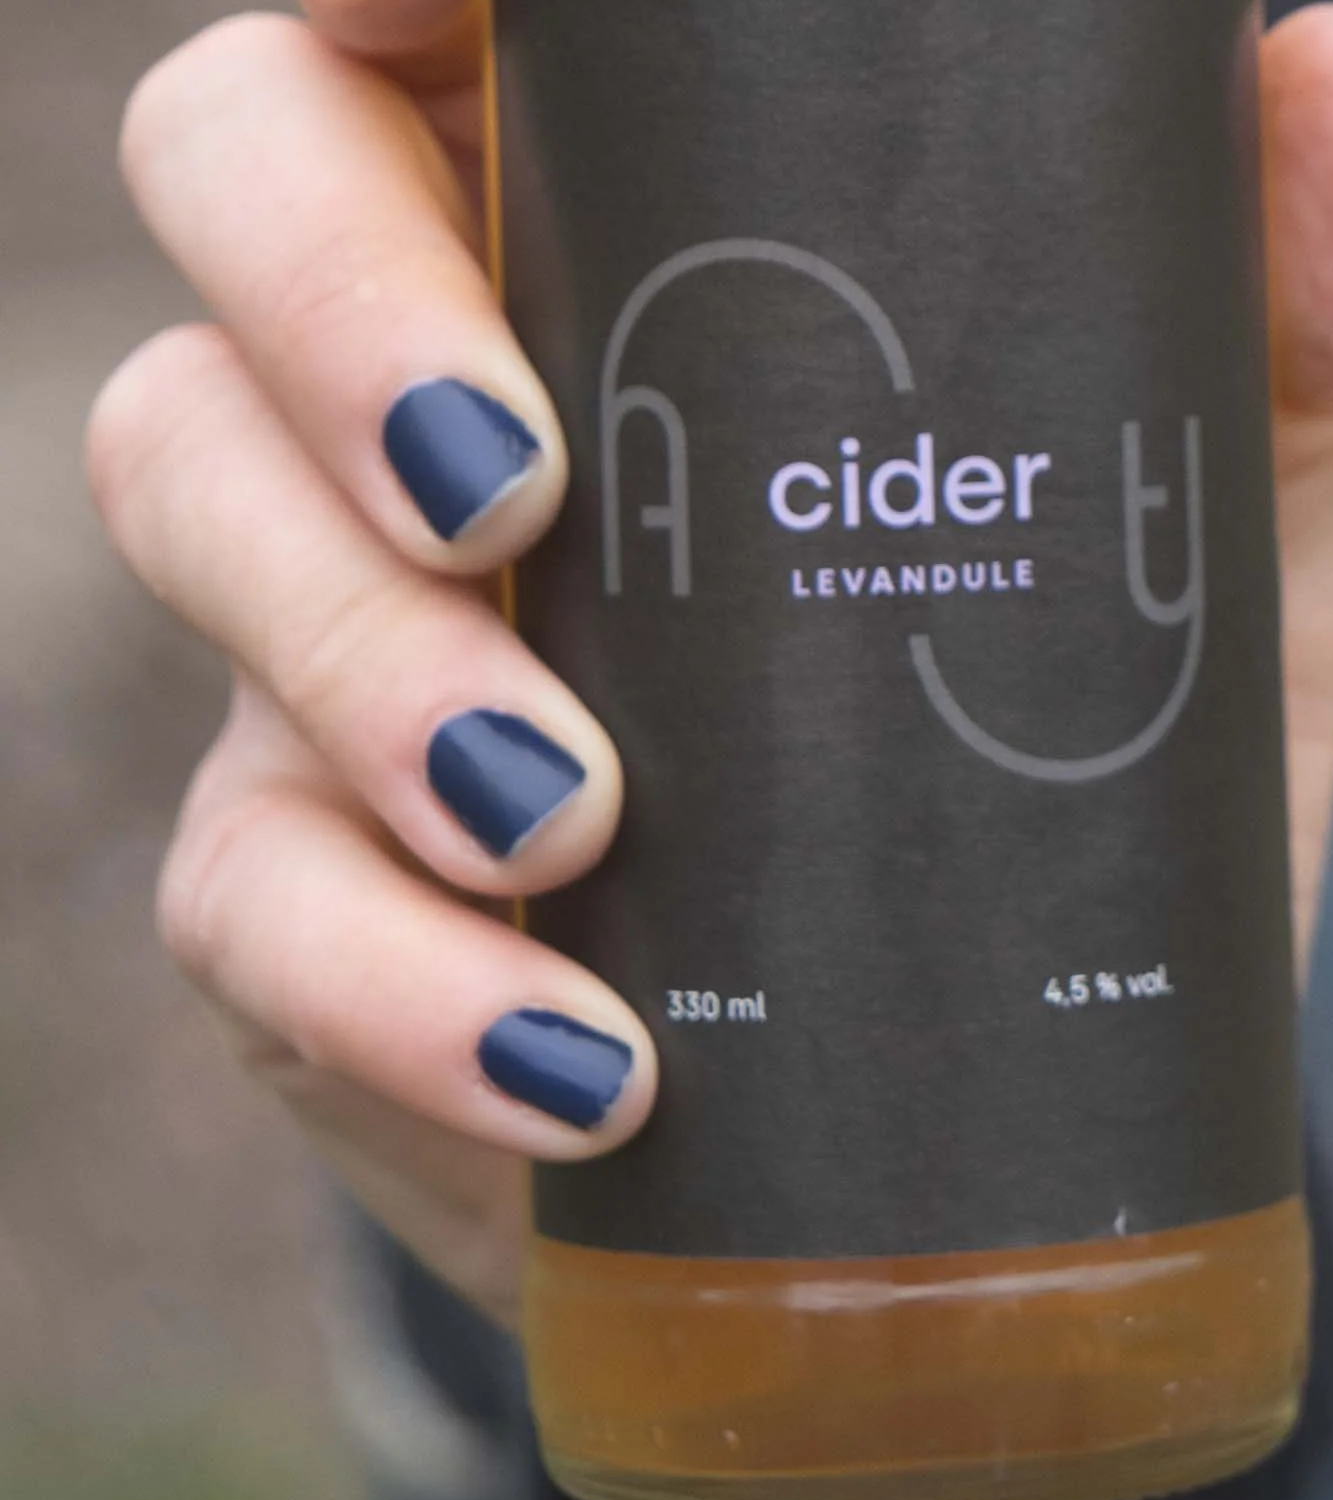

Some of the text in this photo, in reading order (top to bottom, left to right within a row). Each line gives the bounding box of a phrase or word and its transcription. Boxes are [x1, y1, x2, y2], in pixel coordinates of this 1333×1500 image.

[769, 432, 1051, 531] cider
[791, 559, 1035, 599] LEVANDULE
[666, 989, 767, 1021] 330 ml
[1043, 973, 1090, 1008] 4,5
[1094, 971, 1122, 1001] %
